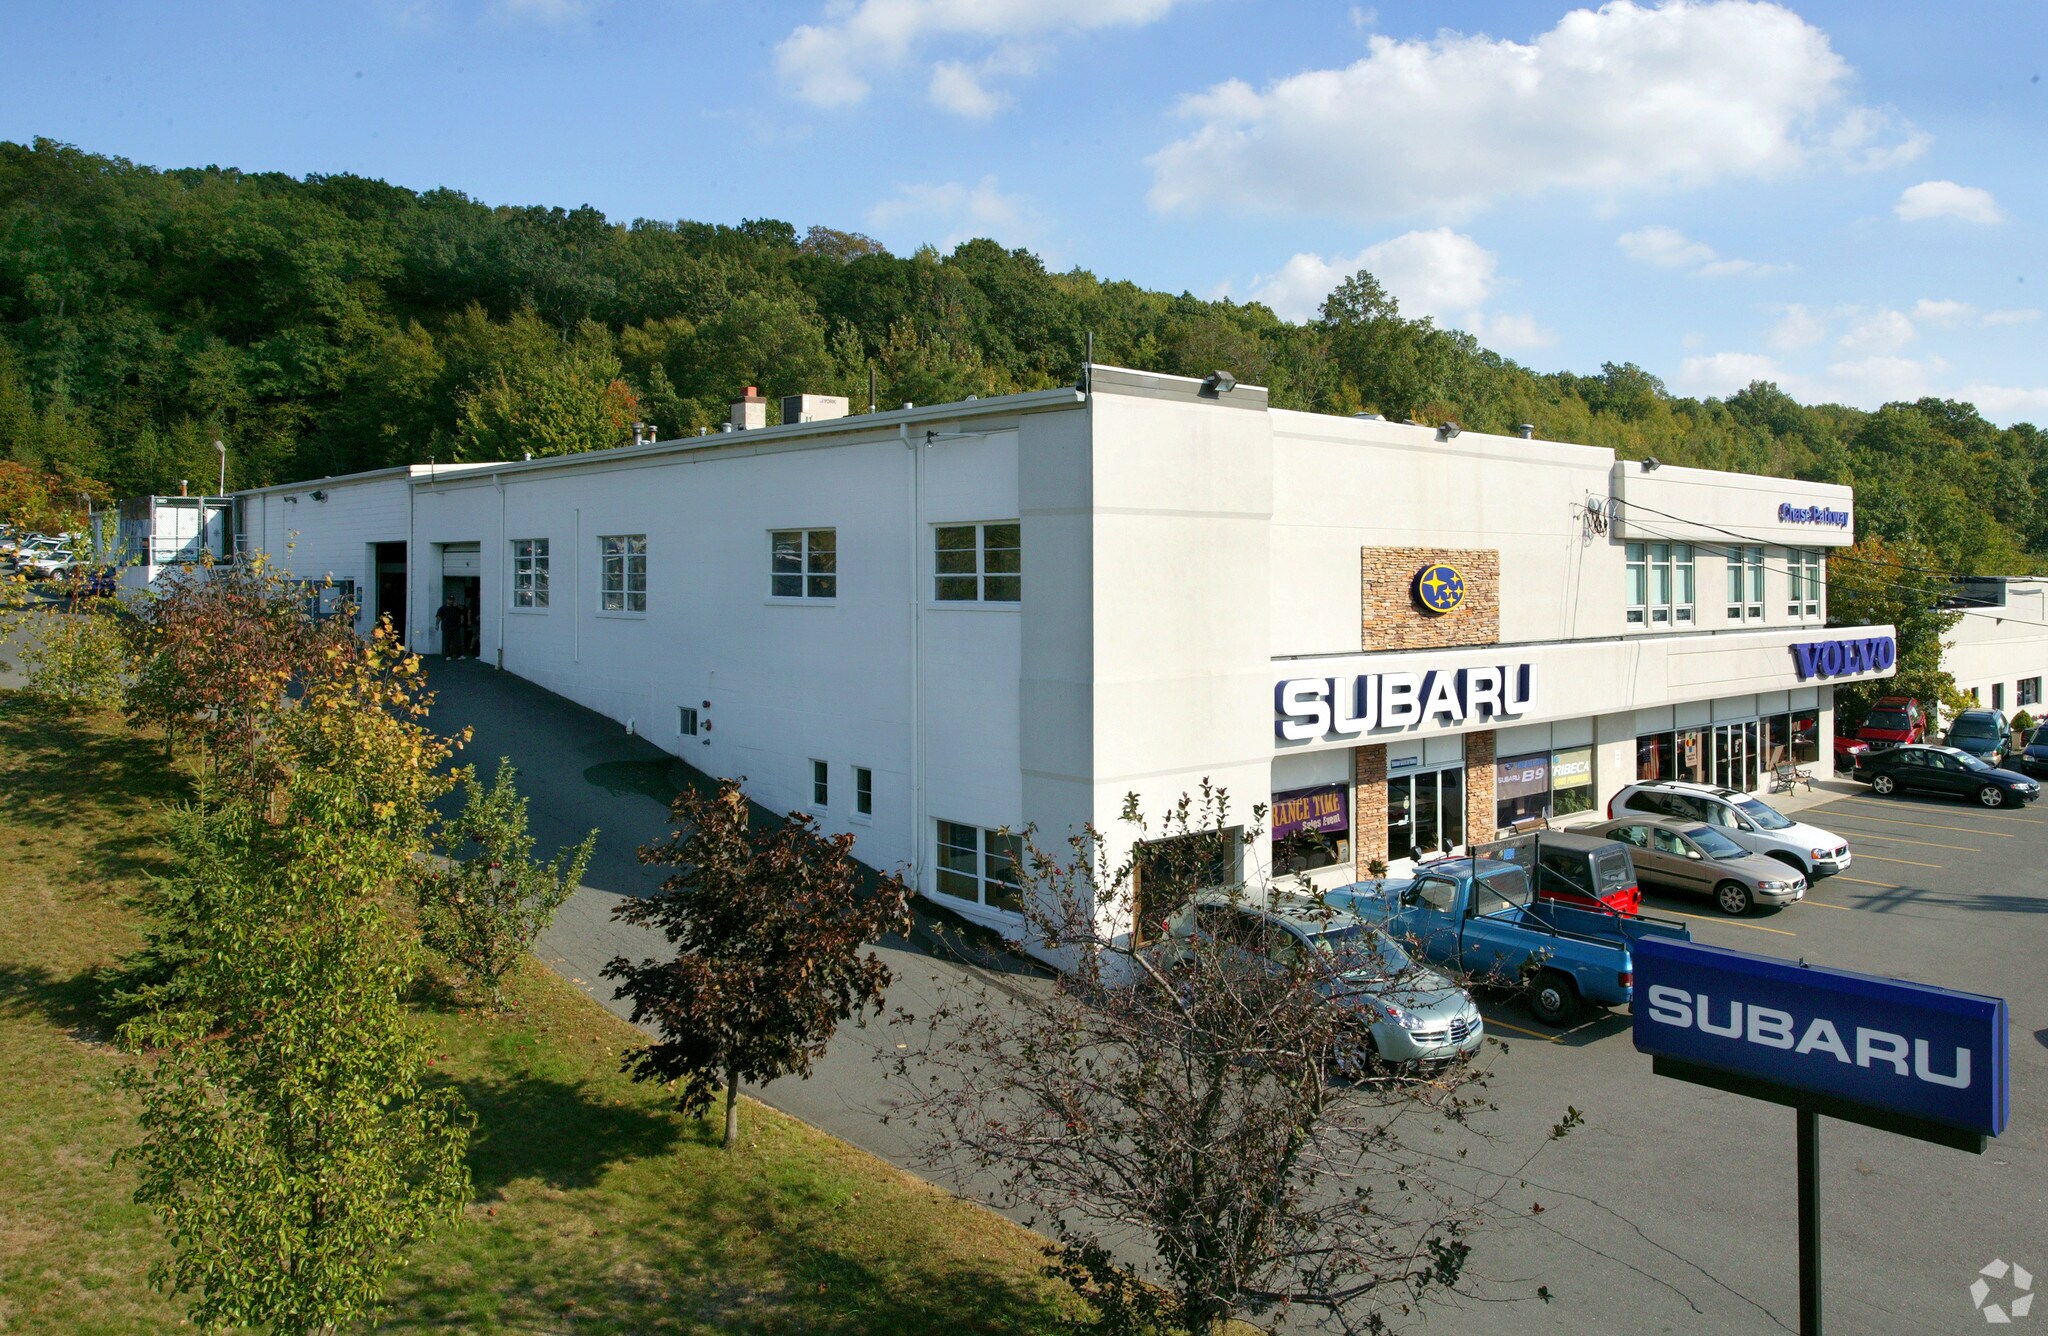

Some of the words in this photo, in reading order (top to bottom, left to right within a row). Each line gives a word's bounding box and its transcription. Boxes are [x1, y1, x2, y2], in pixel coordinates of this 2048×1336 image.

[1778, 503, 1810, 523] Chase
[1809, 505, 1849, 530] Parkway
[1790, 636, 1895, 679] VOLVO
[1274, 663, 1538, 741] SUBARU
[1521, 767, 1545, 783] B9
[1312, 793, 1340, 817] TIME
[1302, 818, 1322, 831] Sales
[1322, 813, 1341, 826] Event
[1648, 984, 1971, 1090] SUBARU
